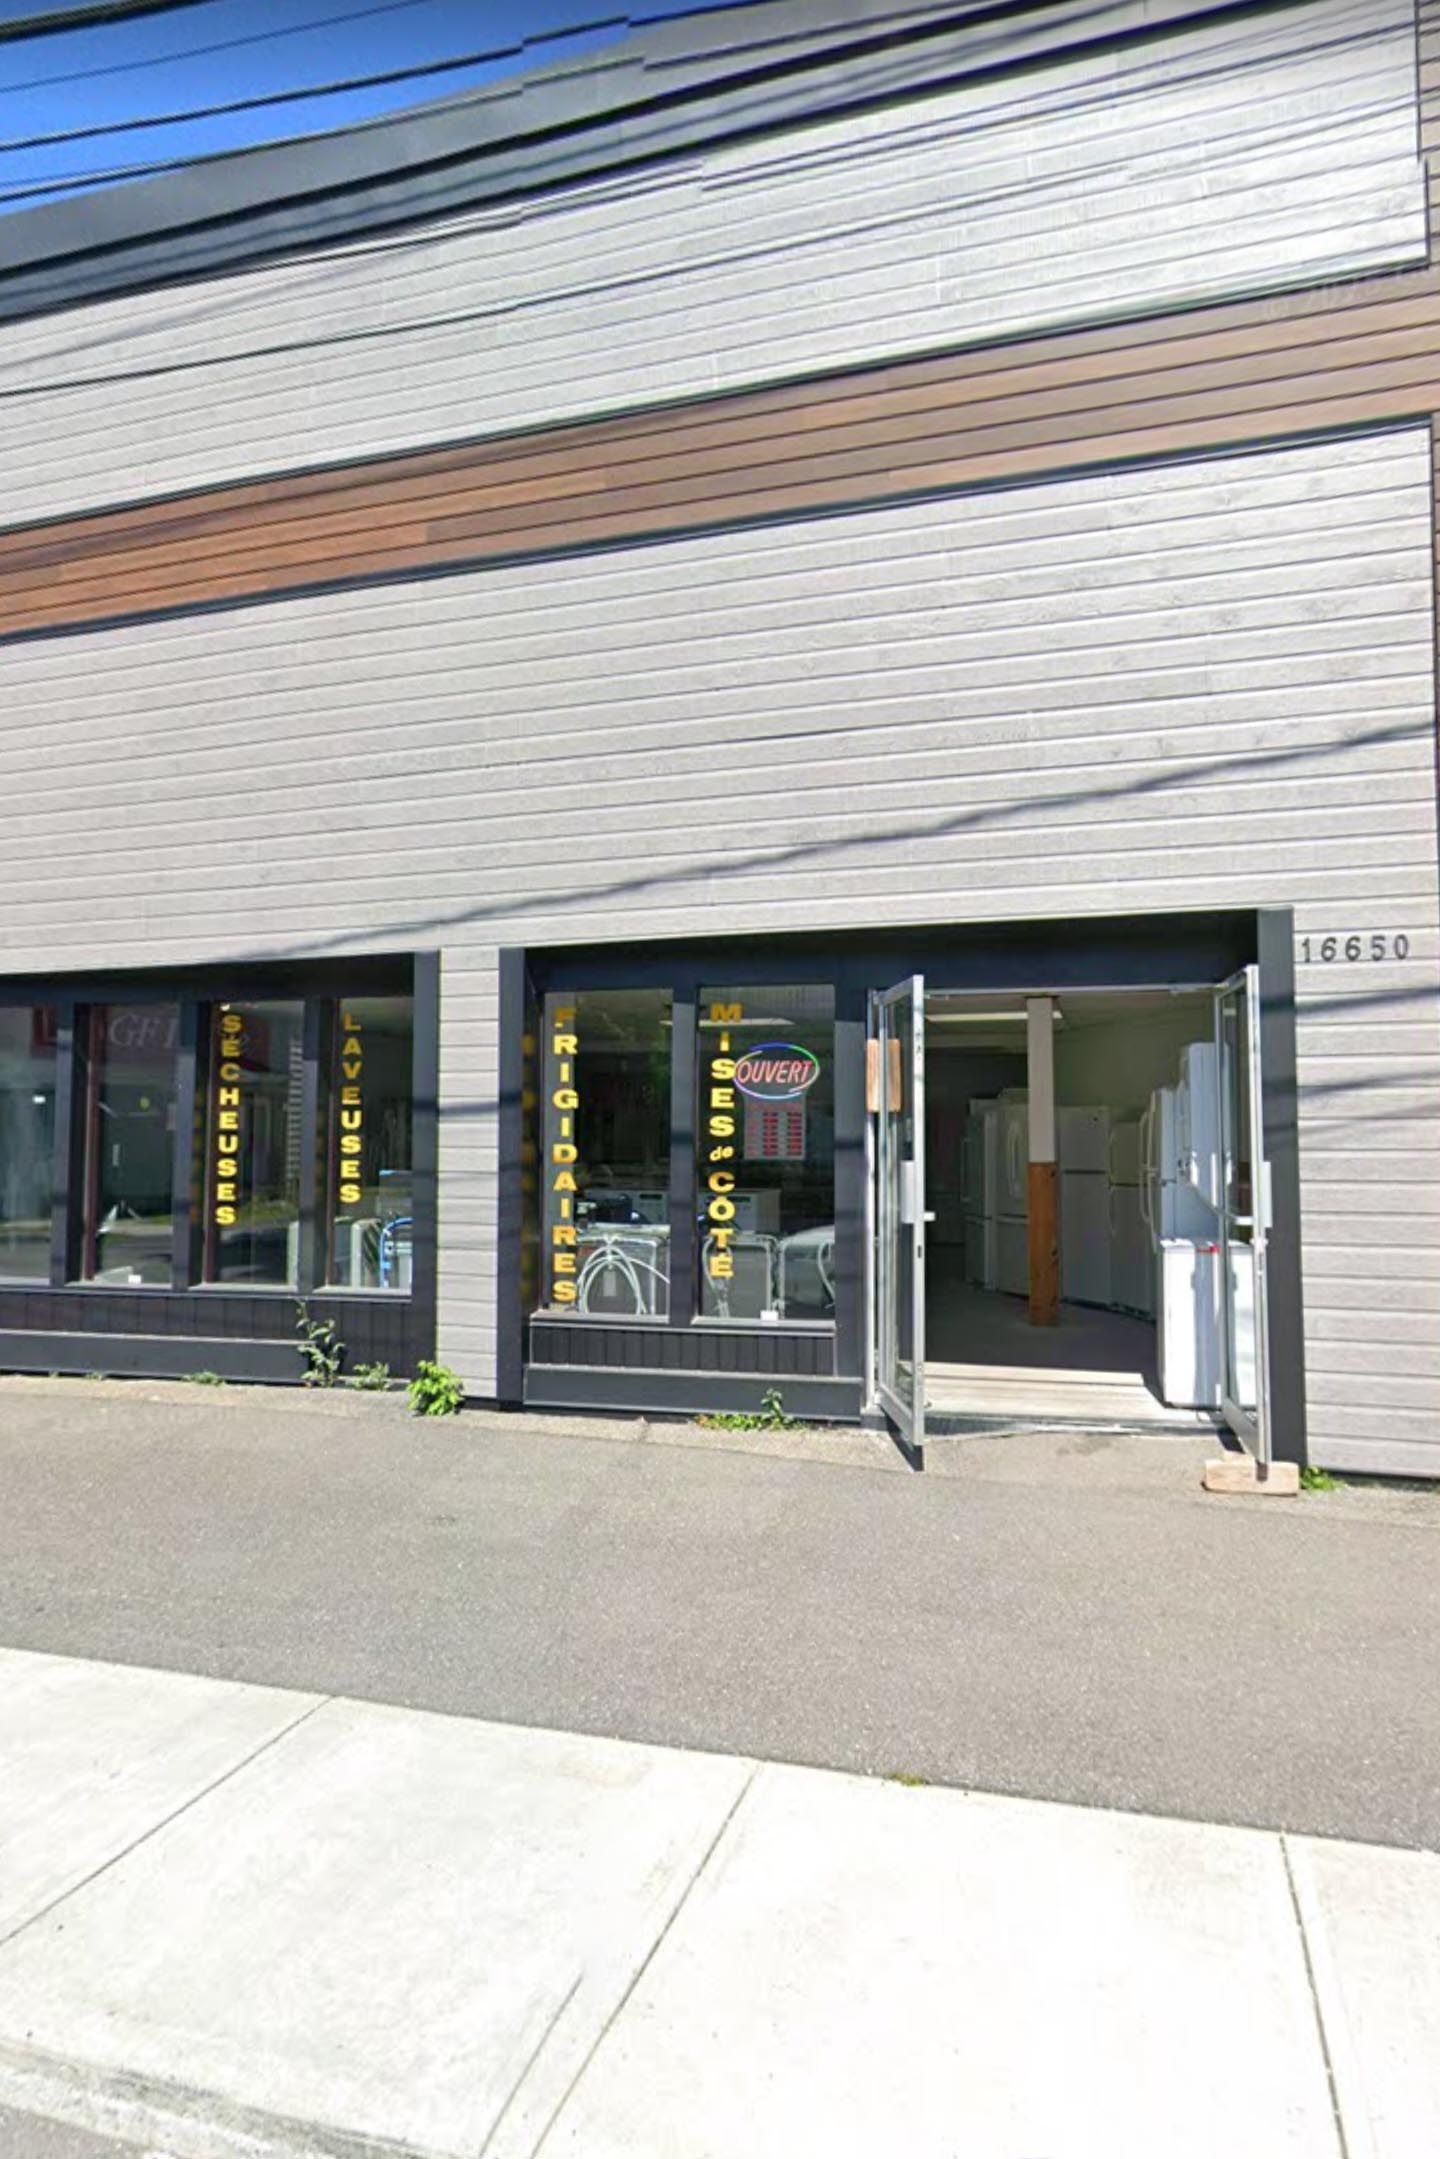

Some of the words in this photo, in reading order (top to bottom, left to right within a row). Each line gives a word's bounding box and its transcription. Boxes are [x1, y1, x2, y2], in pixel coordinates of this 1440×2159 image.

[1301, 934, 1409, 963] 16650
[340, 1013, 362, 1204] LAVEUSES
[737, 1060, 813, 1084] OUVERT
[553, 1007, 579, 1303] FRIGIDAIRES
